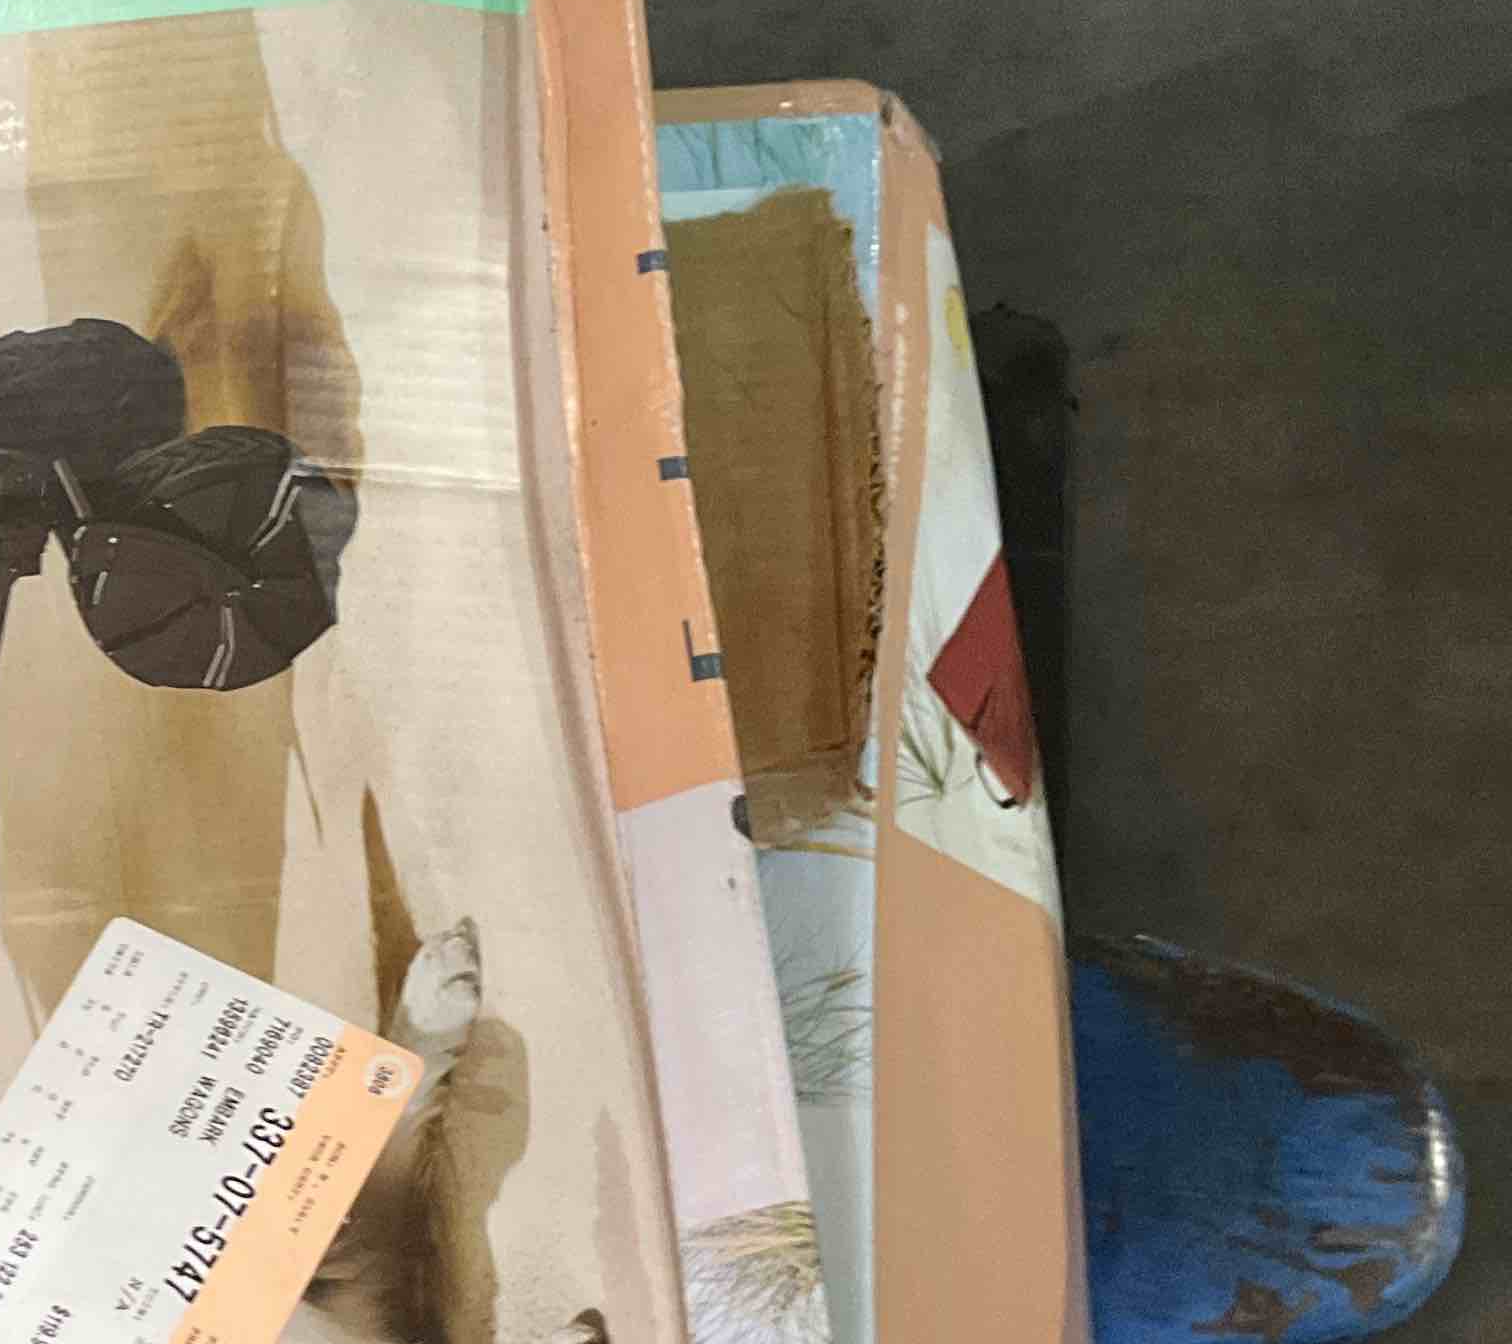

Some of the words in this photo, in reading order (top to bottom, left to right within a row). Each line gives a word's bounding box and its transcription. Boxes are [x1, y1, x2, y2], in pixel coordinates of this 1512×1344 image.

[166, 1072, 217, 1139] WAGONS
[196, 1085, 245, 1147] EMBARK
[159, 1105, 296, 1304] 337-07-5747
